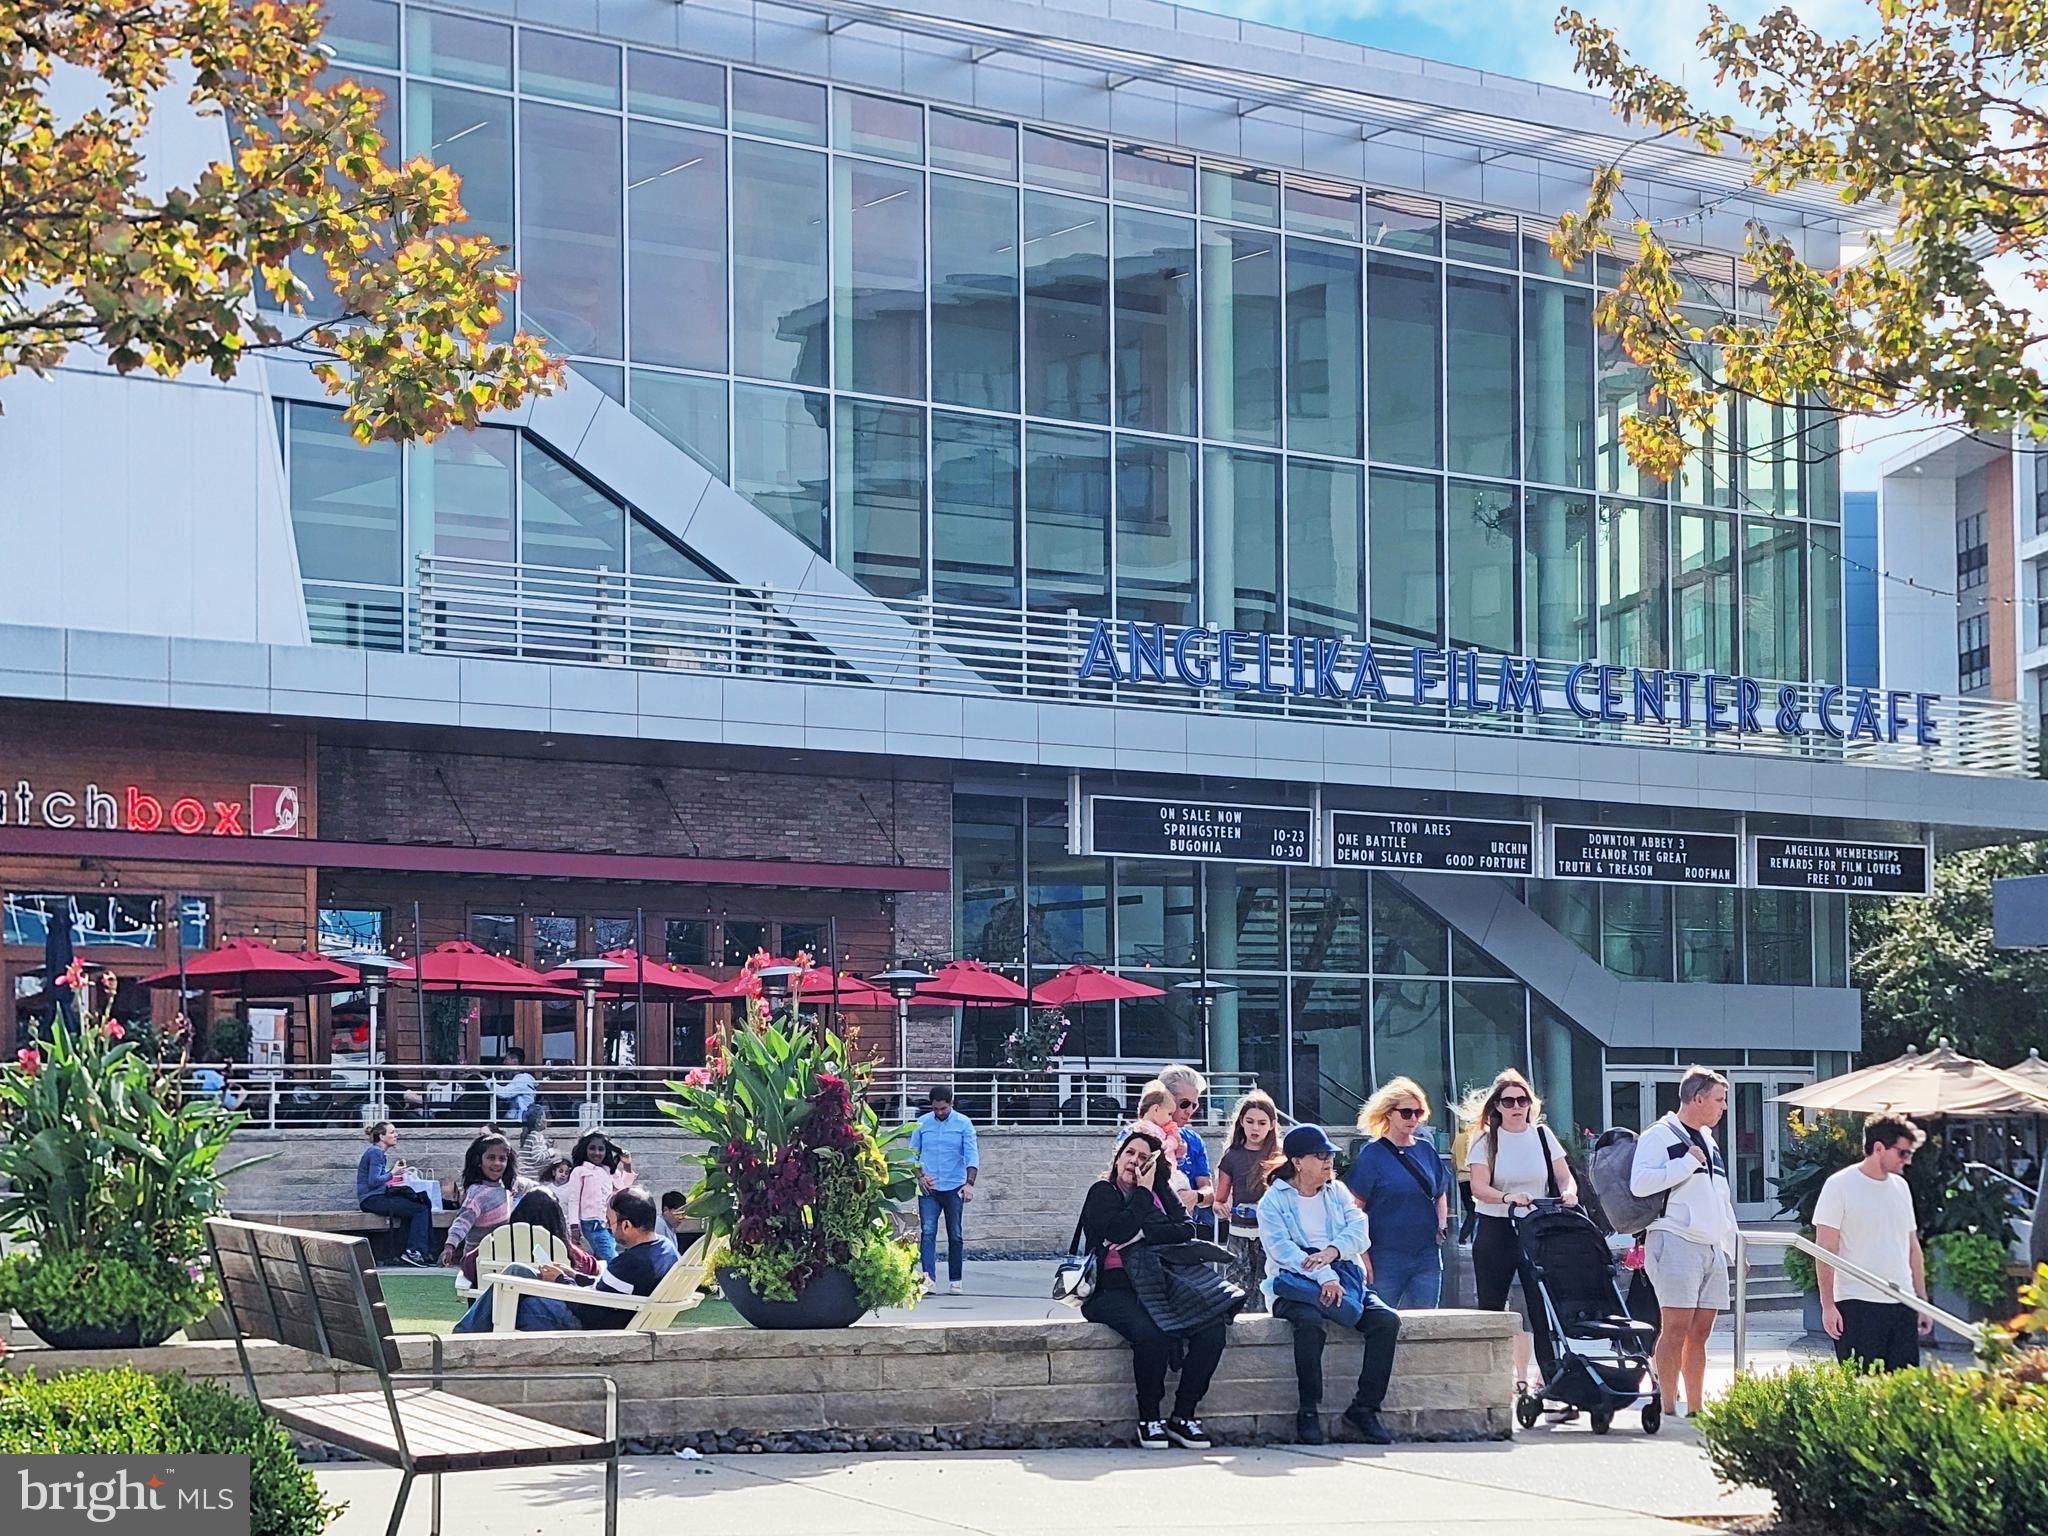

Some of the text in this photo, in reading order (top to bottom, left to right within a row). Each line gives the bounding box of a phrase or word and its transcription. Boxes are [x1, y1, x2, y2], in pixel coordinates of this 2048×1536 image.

[1079, 618, 1941, 745] ANGELIKA FILM CENTER & CAFE
[0, 780, 244, 837] tchbox
[1160, 807, 1242, 823] ON SALE NOW
[1164, 823, 1305, 843] SPRINGSTEEN 10-23
[1390, 821, 1451, 836] TRON ARES
[1170, 839, 1303, 858] BUGONIA 10-30
[1338, 833, 1407, 848] ONE BATTLE
[1491, 842, 1528, 855] URCHIN
[1589, 833, 1685, 850] DOWNTON ABBEY 3
[1338, 849, 1423, 864] DEMON SLAYER
[1582, 847, 1688, 864] ELEANOR THE GREAT
[1784, 844, 1900, 862] ANGELIKA MEMBERSHIPS
[1445, 854, 1526, 870] GOOD FORTUNE
[1558, 860, 1653, 877] TRUTH & TREASON
[1770, 857, 1902, 876] REWARDS FOR FILM LOVERS
[1685, 867, 1731, 880] ROOFMAN
[1807, 873, 1873, 887] FREE TO JOIN
